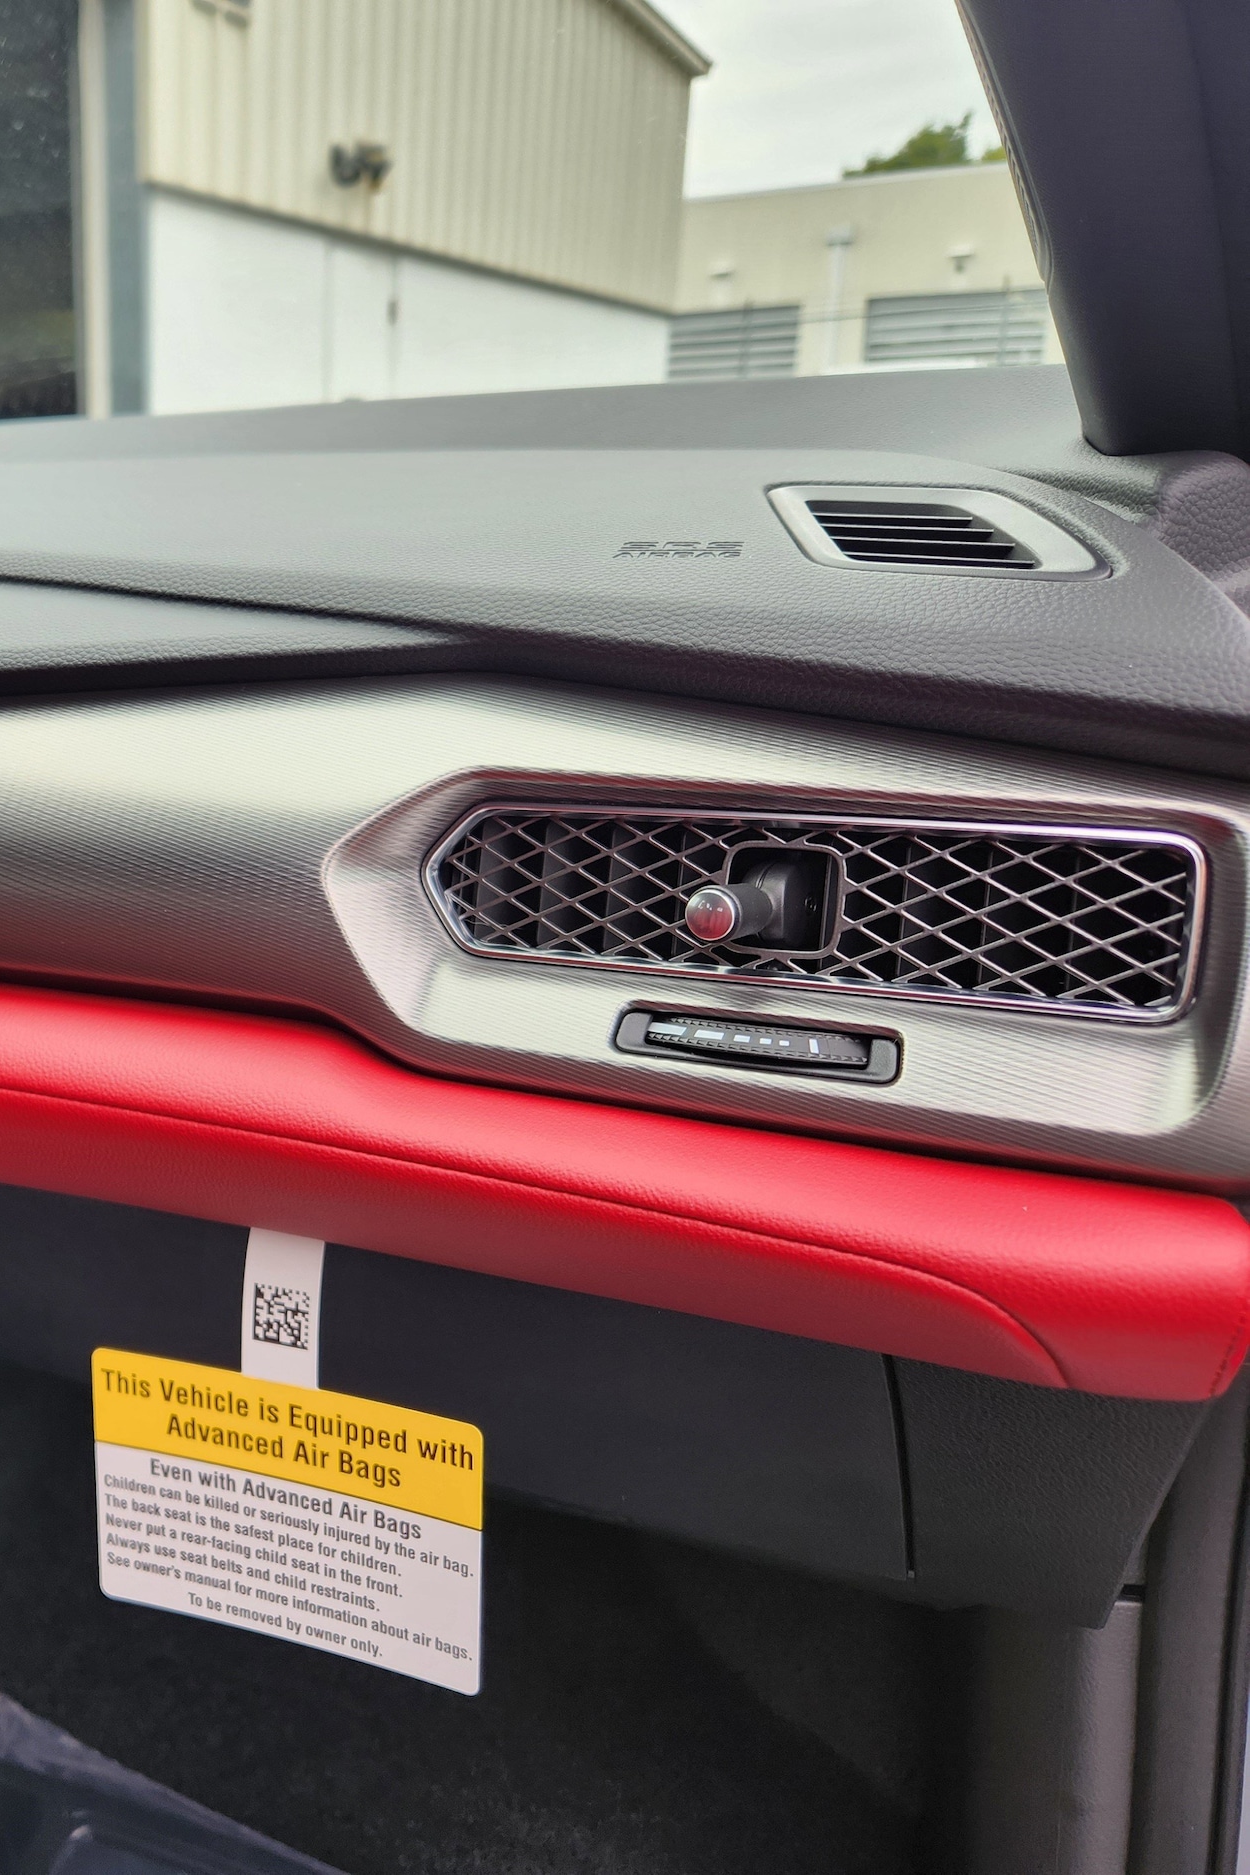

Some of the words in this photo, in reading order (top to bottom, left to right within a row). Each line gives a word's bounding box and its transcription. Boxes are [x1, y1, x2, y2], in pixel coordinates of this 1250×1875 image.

[612, 551, 742, 559] AIRBAG
[621, 540, 745, 550] SRS
[101, 1368, 150, 1398] This
[159, 1378, 249, 1417] Vehicle
[259, 1397, 279, 1423] is
[289, 1404, 407, 1454] Equipped
[417, 1439, 473, 1471] with
[167, 1413, 283, 1459] Advanced
[293, 1440, 329, 1468] Air
[339, 1449, 400, 1488] Bags
[103, 1473, 156, 1496] Children
[159, 1487, 182, 1501] can
[185, 1489, 200, 1505] be
[203, 1494, 239, 1514] killed
[242, 1505, 257, 1518] or
[259, 1509, 320, 1536] seriously
[323, 1522, 370, 1547] injured
[374, 1535, 391, 1555] by
[394, 1541, 415, 1560] the
[419, 1550, 439, 1566] air
[443, 1555, 474, 1578] bag.
[104, 1492, 128, 1510] The
[131, 1498, 161, 1516] back
[164, 1508, 192, 1523] seat
[195, 1511, 207, 1526] is
[209, 1515, 230, 1532] the
[234, 1523, 274, 1543] safest
[277, 1532, 314, 1552] place
[317, 1541, 337, 1558] for
[340, 1549, 401, 1577] children.
[150, 1457, 192, 1483] Even
[198, 1471, 236, 1492] with
[242, 1478, 332, 1516] Advanced
[338, 1501, 367, 1524] Air
[373, 1509, 421, 1540] Bags
[105, 1512, 143, 1532] Never
[145, 1523, 166, 1537] put
[169, 1528, 177, 1539] a
[181, 1531, 251, 1559] rear-facing
[255, 1547, 287, 1566] child
[291, 1557, 320, 1575] seat
[323, 1563, 336, 1579] in
[340, 1568, 361, 1586] the
[365, 1575, 402, 1598] front.
[106, 1532, 150, 1554] Always
[154, 1544, 176, 1559] use
[179, 1550, 208, 1566] seat
[211, 1554, 243, 1574] belts
[246, 1566, 270, 1582] and
[274, 1572, 306, 1591] child
[310, 1583, 380, 1612] restraints.
[106, 1551, 130, 1568] See
[184, 1571, 231, 1591] manual
[234, 1580, 252, 1596] for
[255, 1588, 288, 1606] more
[292, 1595, 367, 1628] information
[370, 1619, 409, 1641] about
[412, 1632, 432, 1647] air
[434, 1636, 472, 1661] bags.
[187, 1591, 203, 1607] To
[206, 1596, 222, 1612] be
[225, 1604, 282, 1628] removed
[286, 1616, 302, 1635] by
[305, 1625, 347, 1645] owner
[350, 1638, 383, 1658] only.
